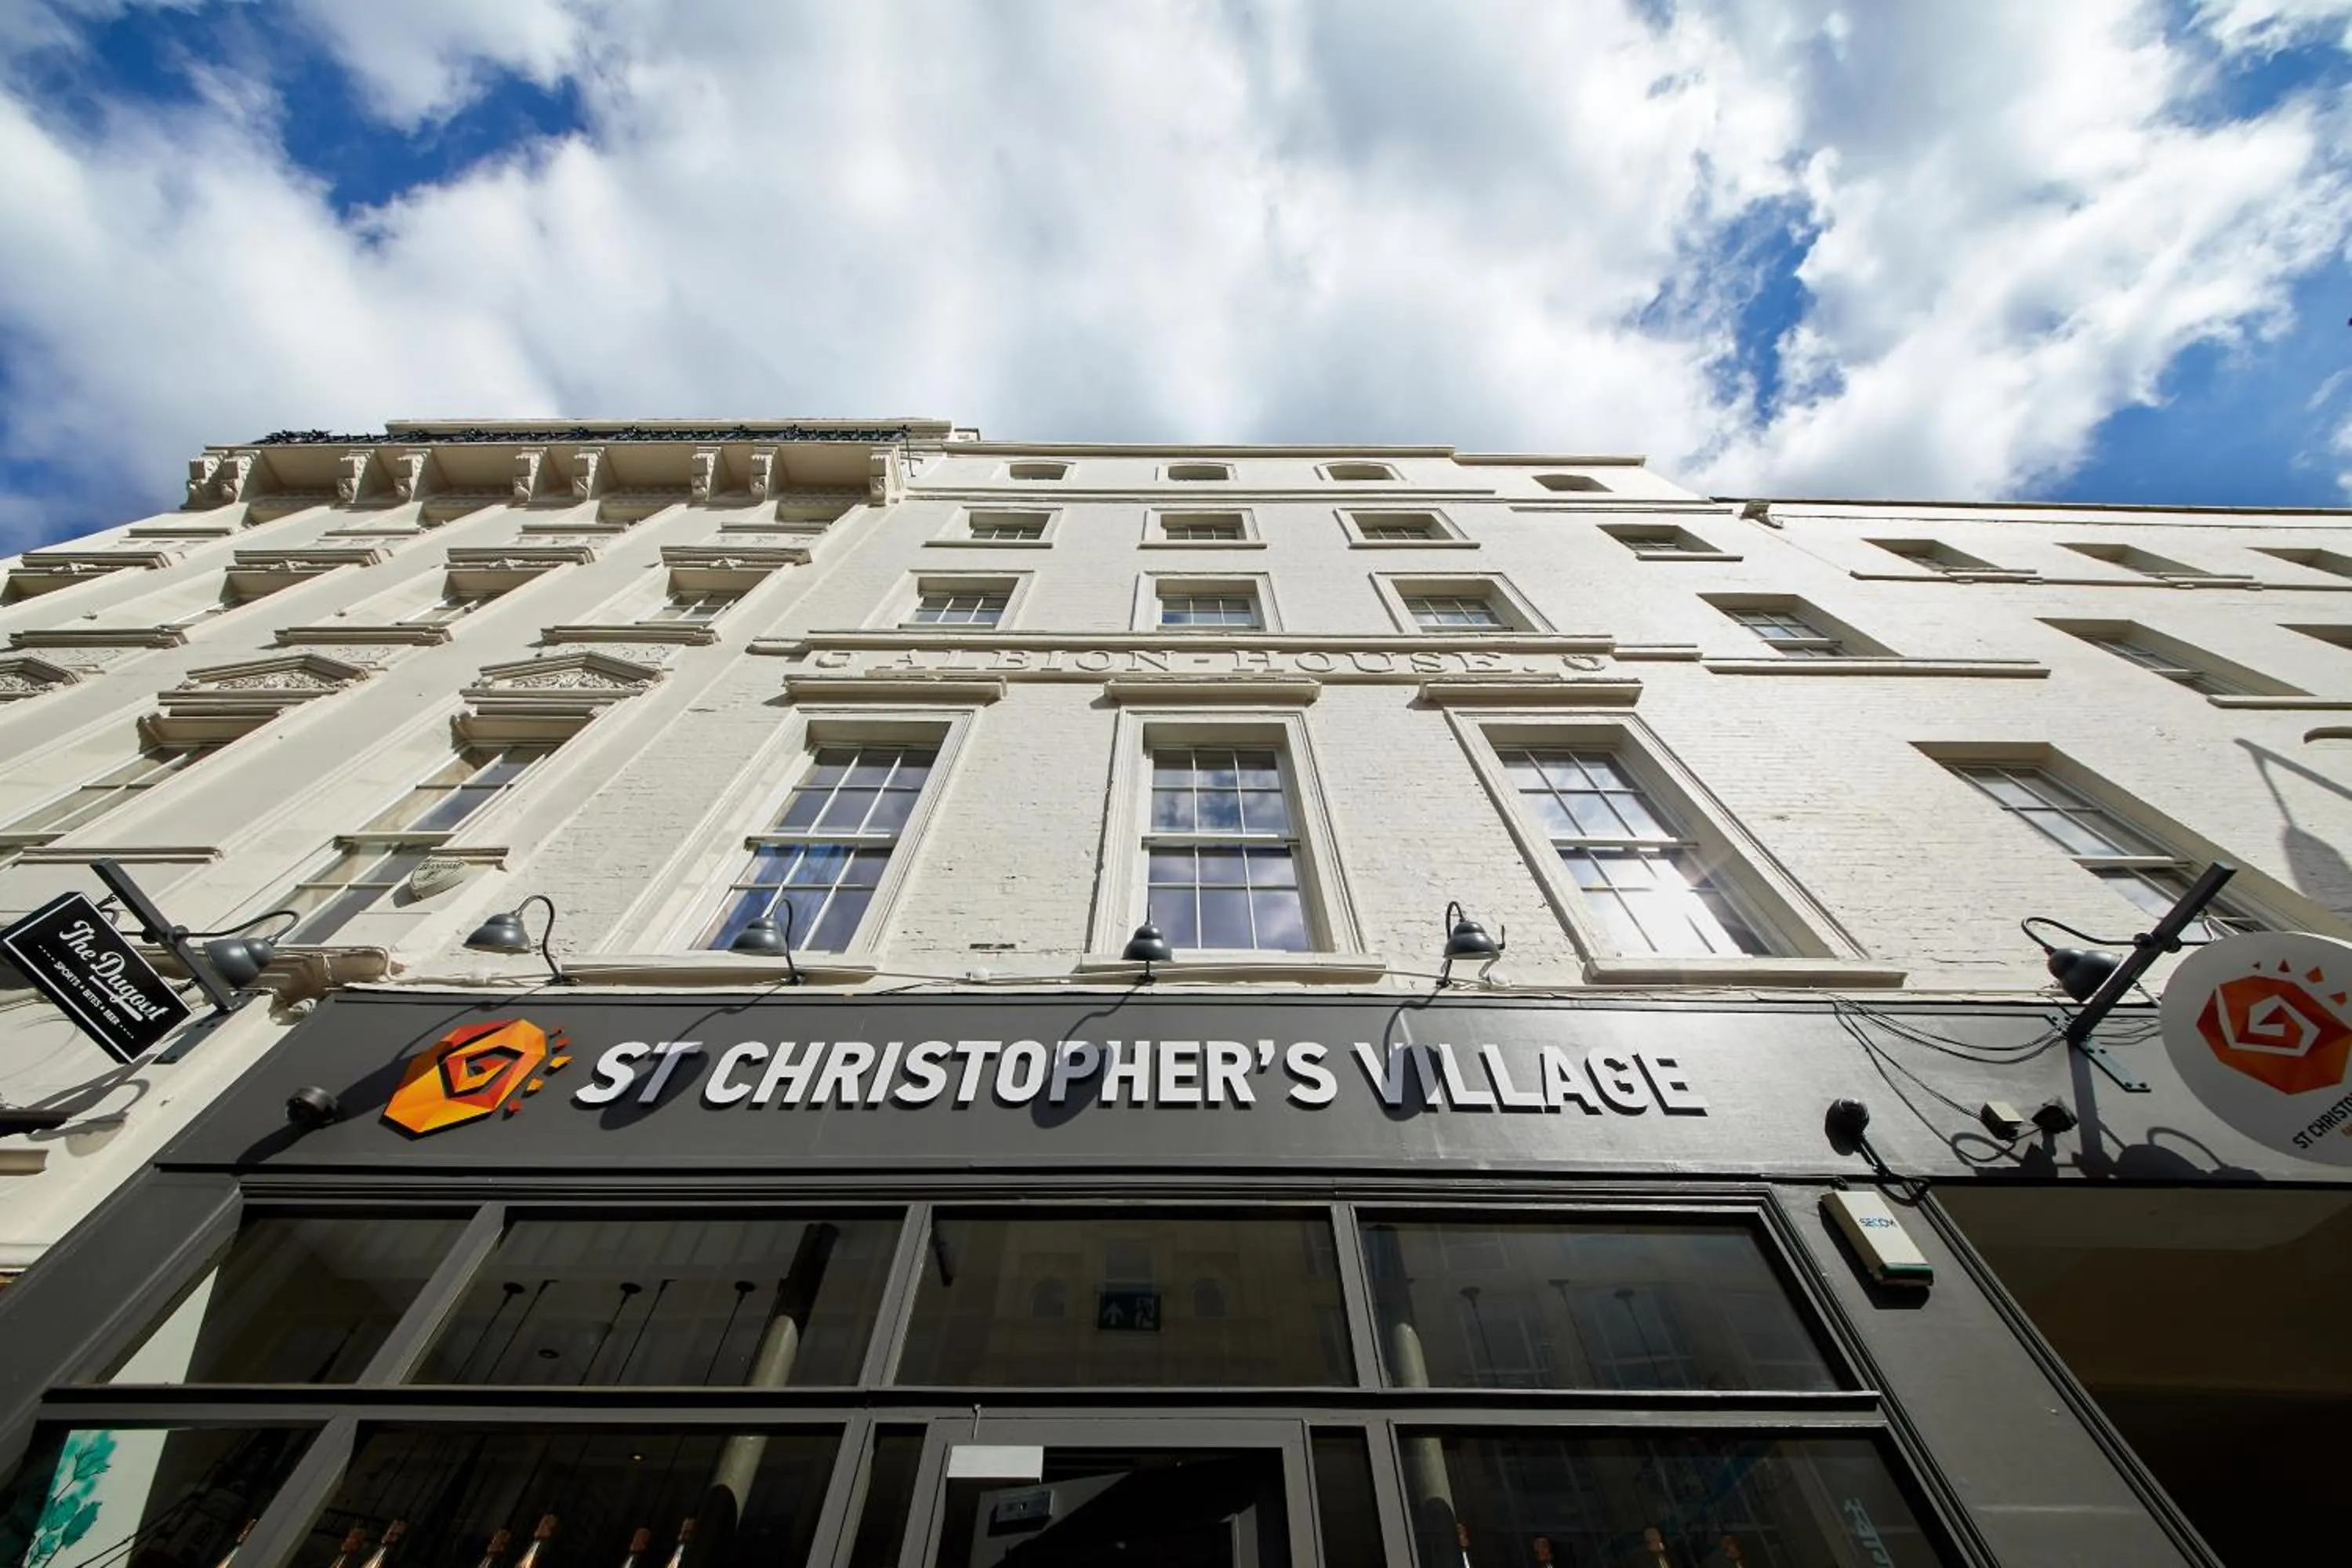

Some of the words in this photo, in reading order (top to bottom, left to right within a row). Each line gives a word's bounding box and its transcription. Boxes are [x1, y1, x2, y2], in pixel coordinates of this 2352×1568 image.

[53, 960, 81, 987] SPORTS
[103, 1009, 120, 1025] BEER
[59, 920, 96, 961] The
[89, 950, 169, 1022] Dugout
[575, 1040, 703, 1104] ST
[705, 1040, 1338, 1104] CHRISTOPHER'S
[1353, 1041, 1708, 1113] VILLAGE
[2292, 1131, 2314, 1149] ST
[2307, 1091, 2352, 1137] CHRISTO
